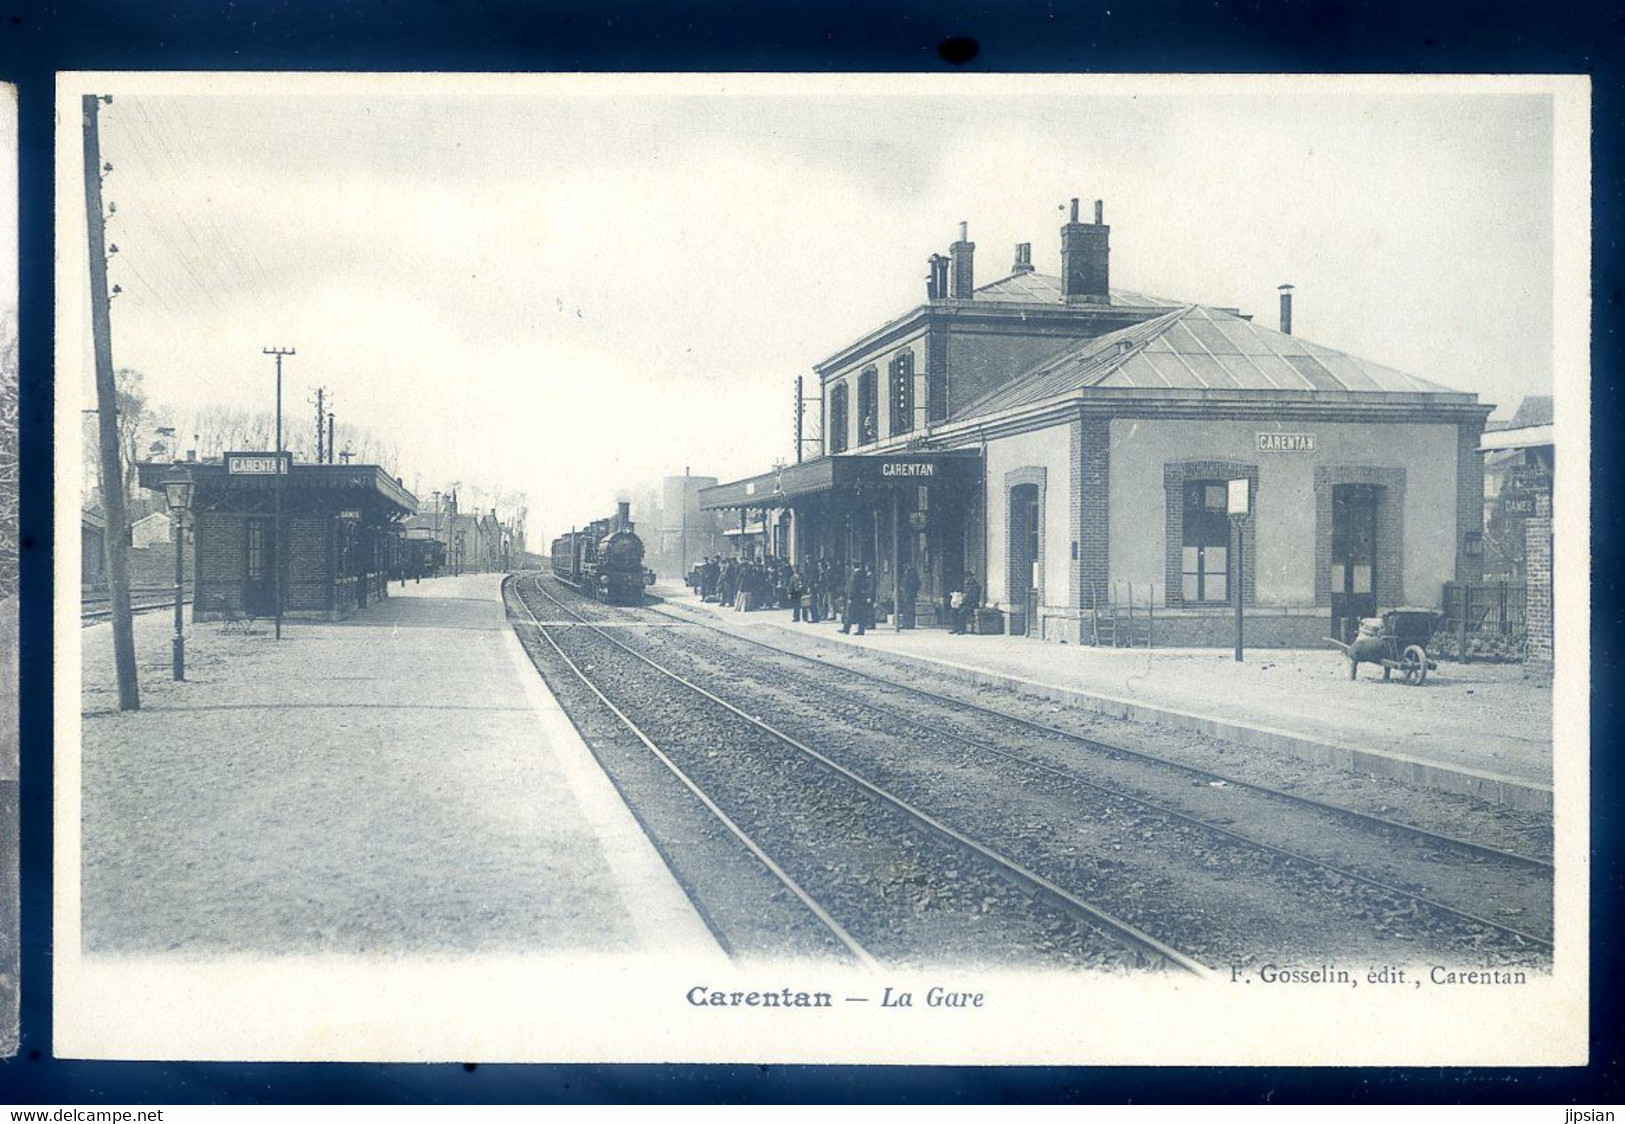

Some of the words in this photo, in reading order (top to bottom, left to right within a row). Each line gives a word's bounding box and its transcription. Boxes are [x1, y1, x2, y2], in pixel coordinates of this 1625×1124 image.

[1260, 435, 1313, 450] CARENTAN
[882, 463, 934, 476] CARENTAN
[1505, 500, 1533, 512] DAMES
